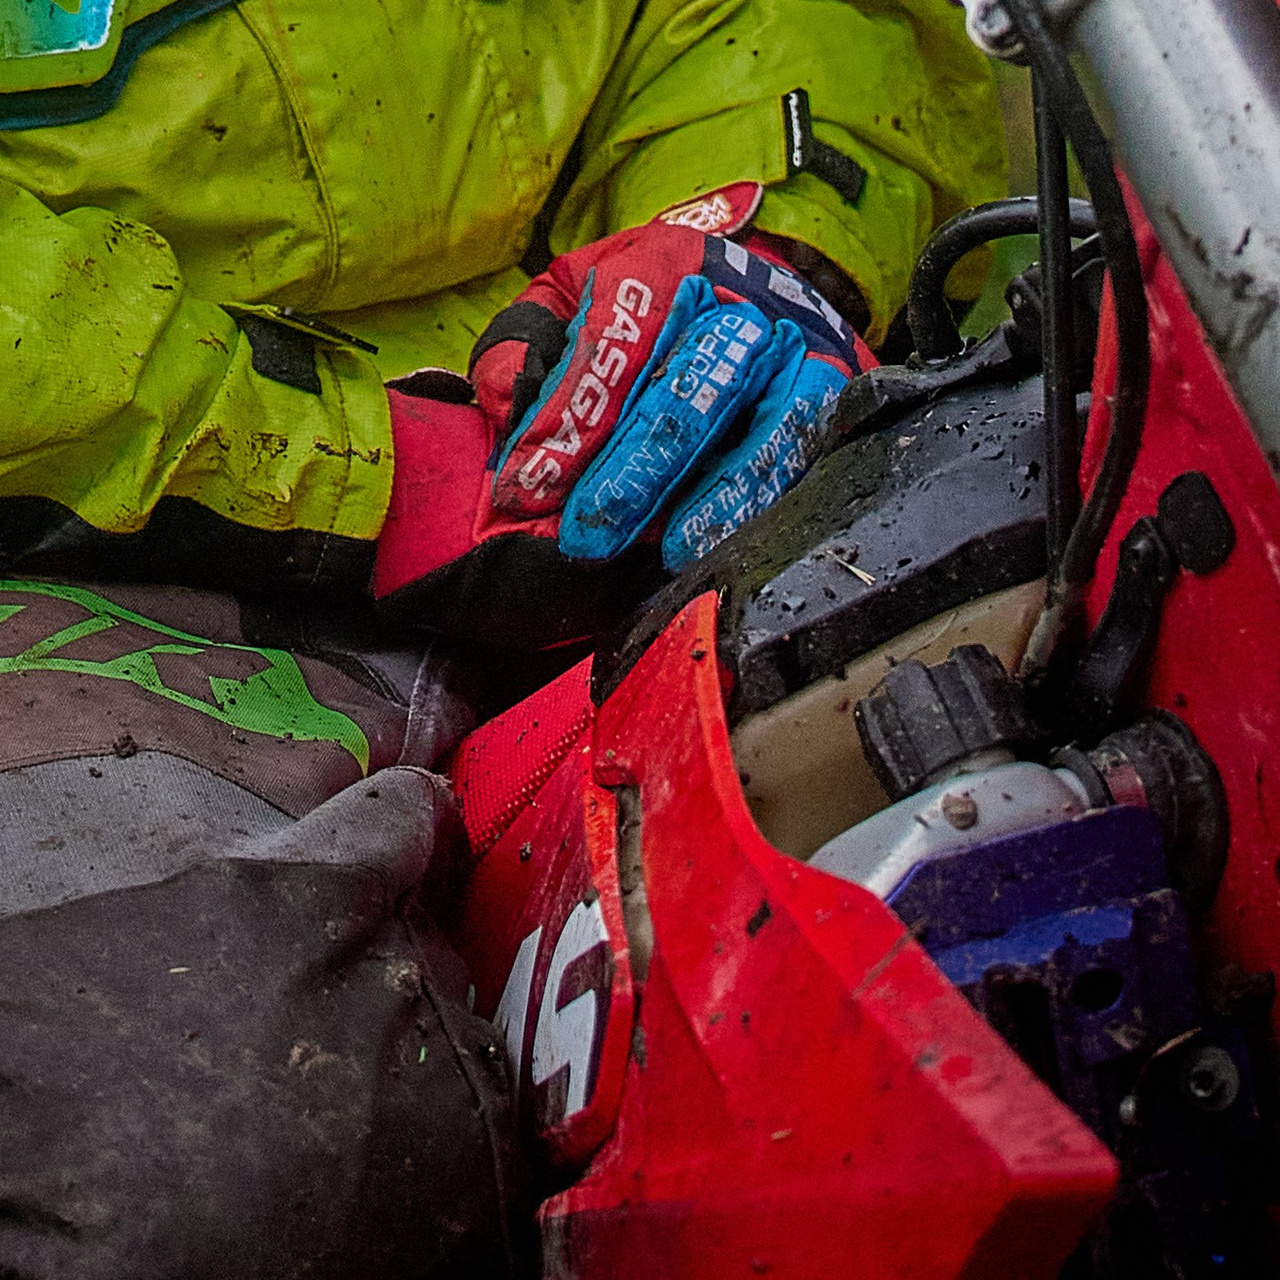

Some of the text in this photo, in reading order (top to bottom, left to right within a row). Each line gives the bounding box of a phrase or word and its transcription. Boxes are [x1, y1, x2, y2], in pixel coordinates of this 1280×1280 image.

[518, 278, 653, 500] GASGAS
[670, 313, 743, 400] GoPro
[681, 502, 718, 547] FOR
[716, 471, 750, 512] THE
